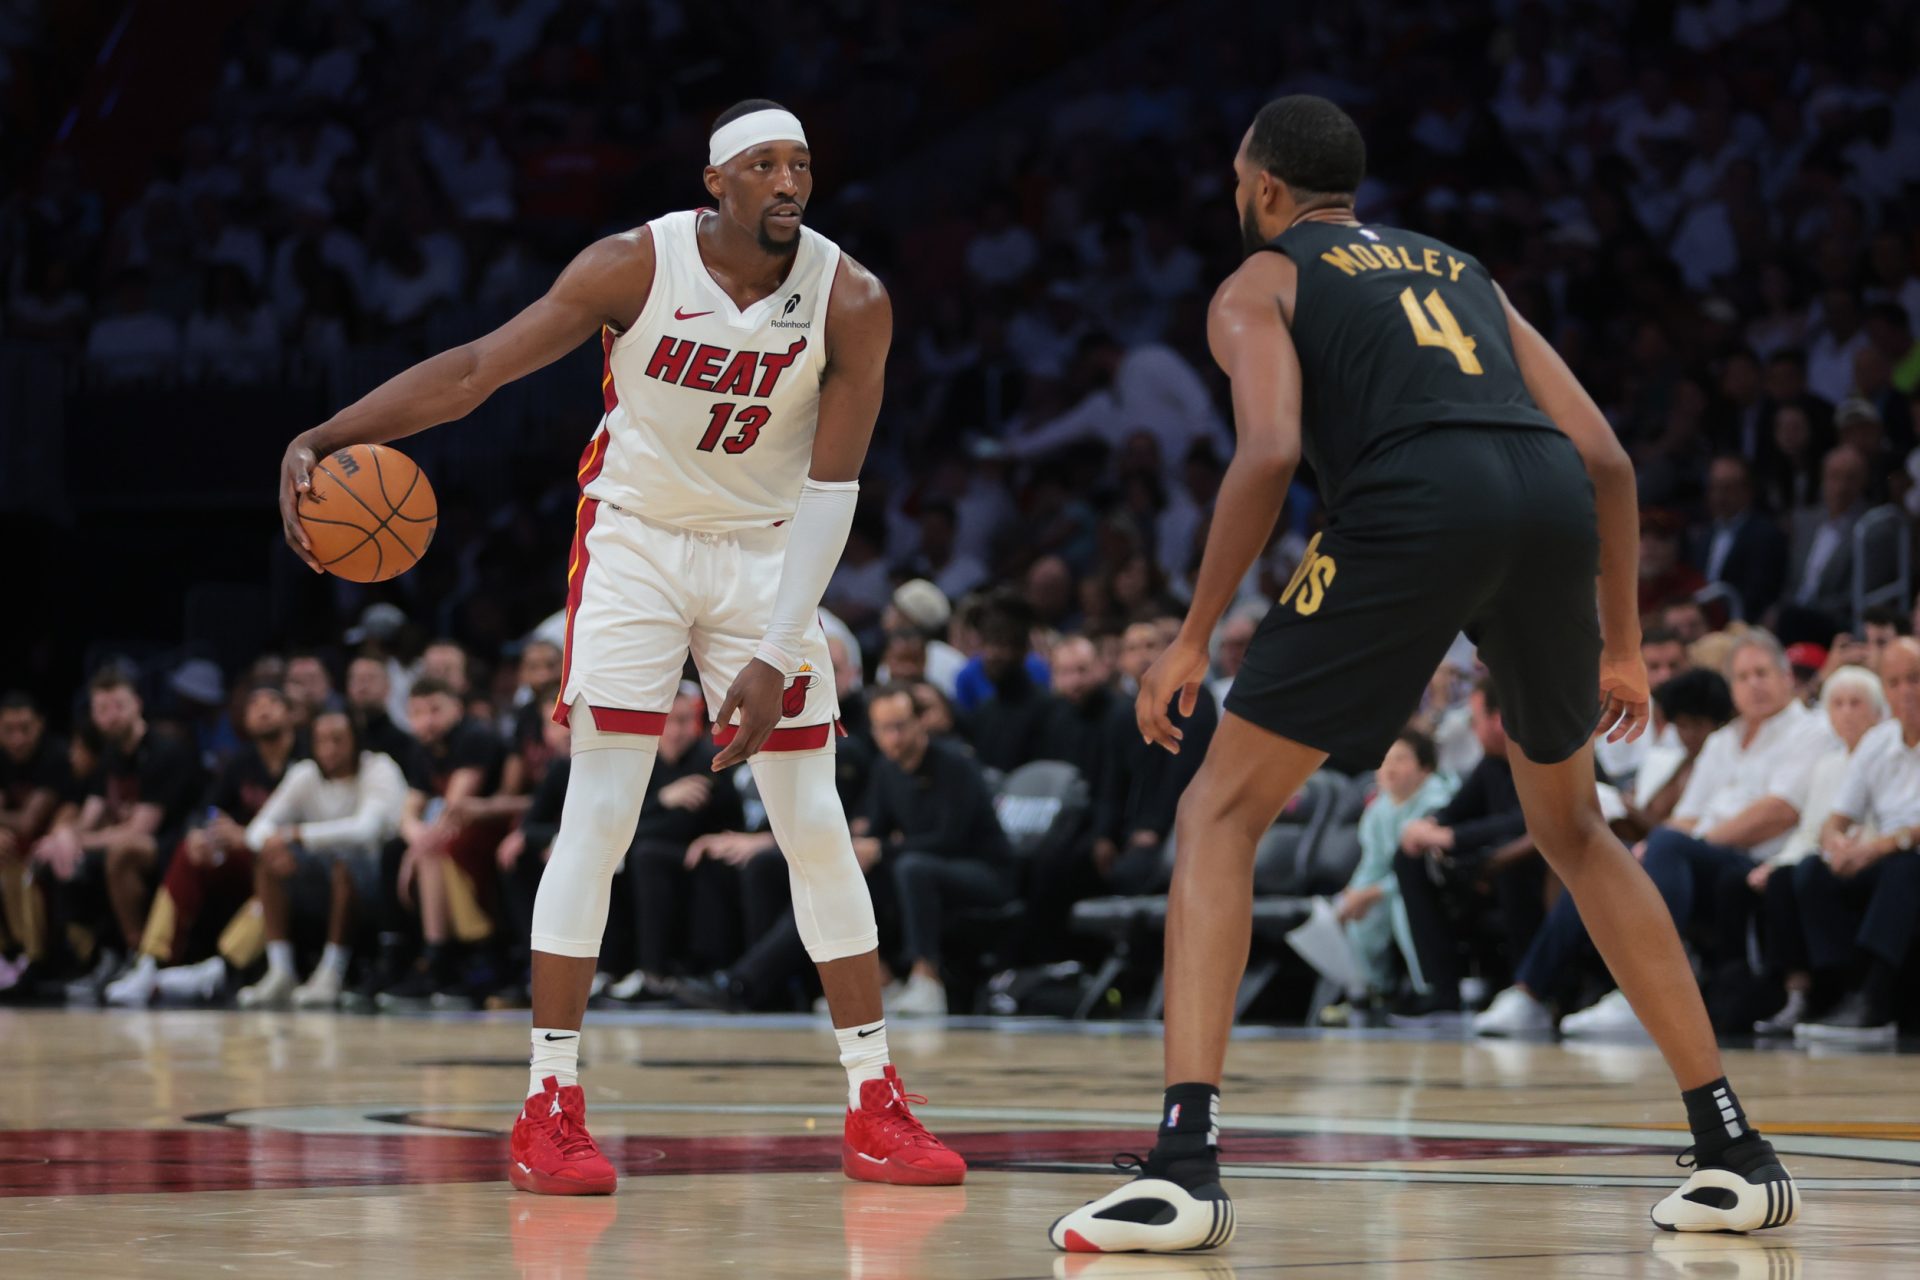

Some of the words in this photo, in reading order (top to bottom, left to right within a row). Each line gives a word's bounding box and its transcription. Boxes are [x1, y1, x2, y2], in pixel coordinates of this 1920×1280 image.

[1320, 243, 1466, 282] MOBLEY
[770, 319, 811, 329] Robinhood
[1399, 286, 1484, 375] 4
[644, 335, 807, 398] HEAT
[696, 402, 771, 454] 13
